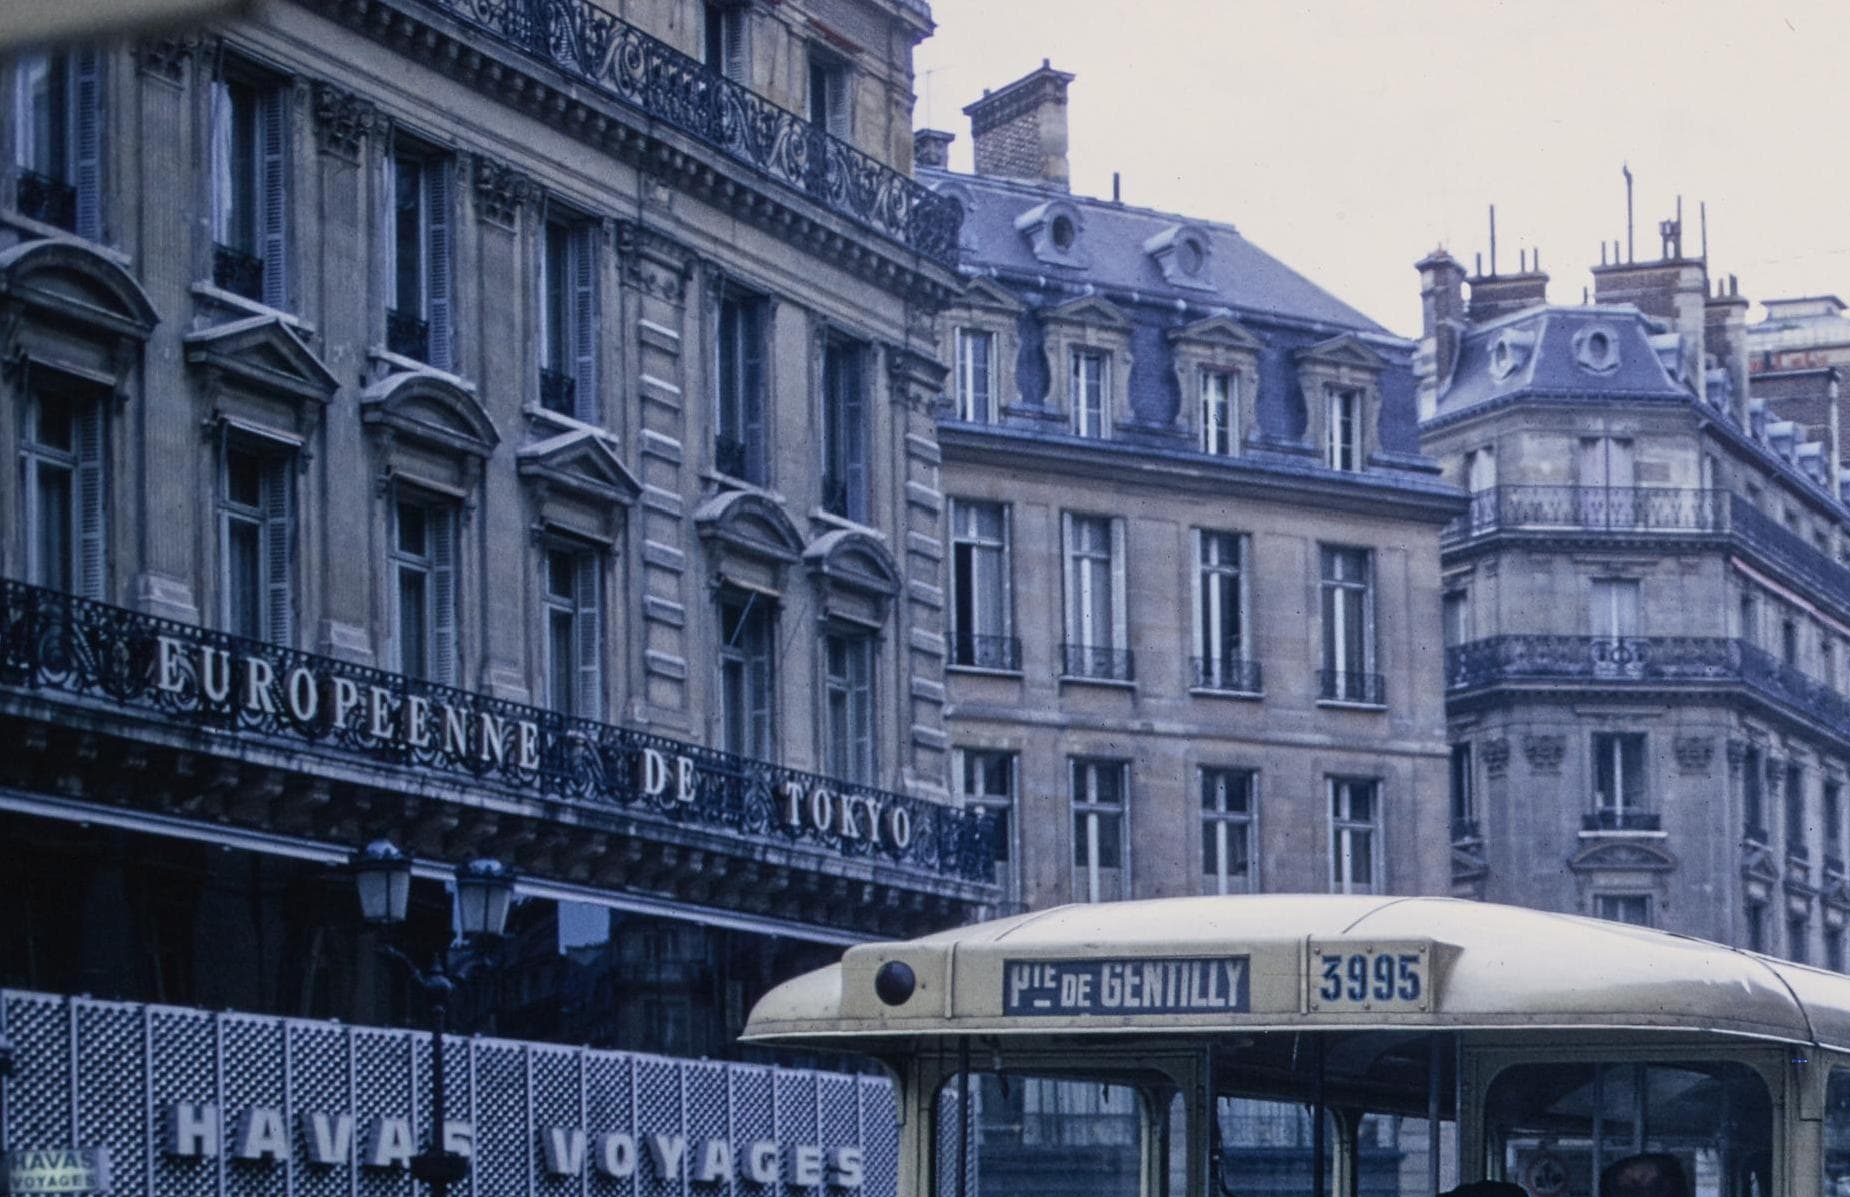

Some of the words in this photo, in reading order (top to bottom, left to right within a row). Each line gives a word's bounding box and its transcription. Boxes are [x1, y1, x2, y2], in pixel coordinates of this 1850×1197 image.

[157, 634, 541, 770] EUROPEENNE
[644, 749, 696, 801] DE
[786, 781, 911, 849] TOKYO
[1062, 973, 1091, 1008] DE
[1101, 959, 1245, 1008] GENTILLY
[1320, 953, 1421, 1001] 3995
[11, 1151, 92, 1169] HAVAS
[547, 1127, 863, 1188] VOYAGES
